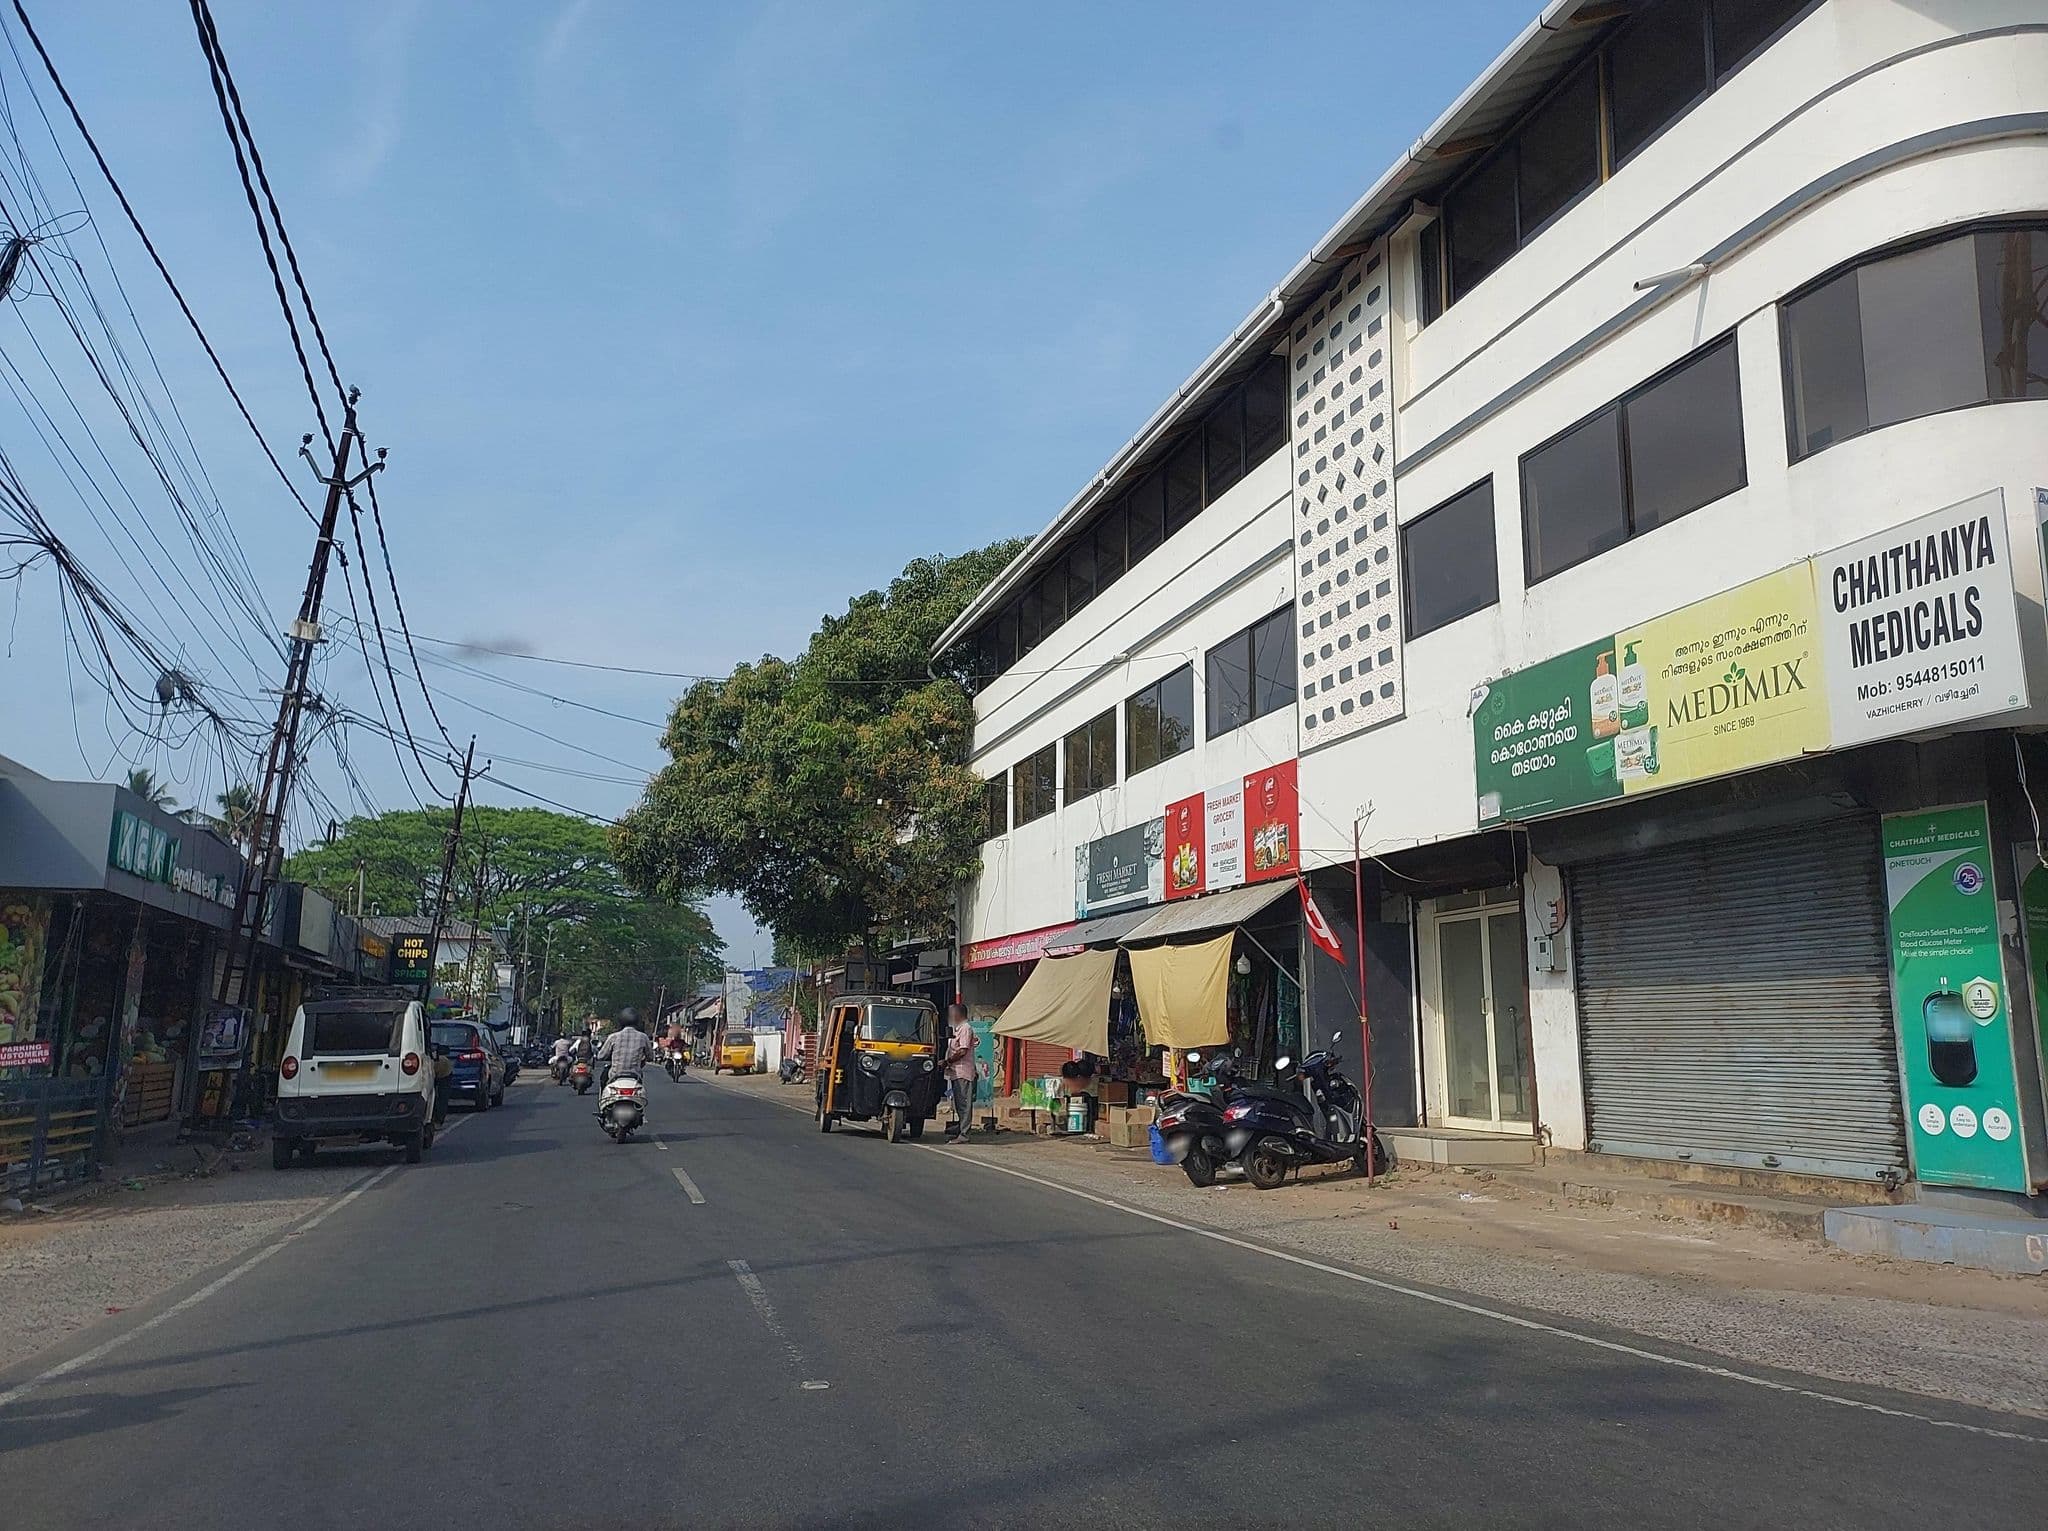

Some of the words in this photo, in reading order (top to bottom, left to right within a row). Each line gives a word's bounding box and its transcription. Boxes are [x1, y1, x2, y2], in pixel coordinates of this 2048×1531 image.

[1832, 516, 1995, 613] CHAITHANYA
[1675, 640, 1710, 658] അന്നും
[1712, 627, 1747, 649] ഇന്നും
[1749, 612, 1789, 634] എന്നും
[1849, 585, 1983, 669] MEDICALS
[1857, 680, 1892, 701] Mob:
[1896, 654, 1985, 691] 9544815011
[1866, 697, 1924, 720] VAZHICHERRY
[1493, 721, 1525, 742] കൈ
[1526, 695, 1573, 731] കഴുകി
[1713, 719, 1737, 736] SINCE
[1738, 715, 1755, 730] 1969
[1511, 753, 1556, 778] തടയാം
[1207, 801, 1222, 813] FRESH
[1222, 792, 1241, 807] MARKET
[1212, 809, 1235, 825] GROCERY
[1889, 834, 1936, 848] CHAITHANY
[1937, 829, 1981, 842] MEDICALS
[1210, 839, 1239, 855] STATIONARY
[1113, 862, 1137, 879] MARKET
[1889, 857, 1932, 870] ONETOUCH
[1961, 872, 1975, 885] 25
[1899, 930, 1930, 938] OneTouch
[1930, 928, 1949, 937] Select
[1949, 927, 1963, 935] Plus
[404, 938, 424, 948] HOT
[1900, 940, 1918, 948] Blood
[1918, 939, 1943, 947] Glucose
[397, 948, 429, 959] CHIPS
[408, 959, 416, 968] &
[394, 969, 428, 978] SPICES
[0, 1049, 50, 1060] USTOMERS
[1, 1044, 42, 1053] PARKING
[0, 1058, 26, 1067] EHICLE
[27, 1057, 47, 1065] ONLY
